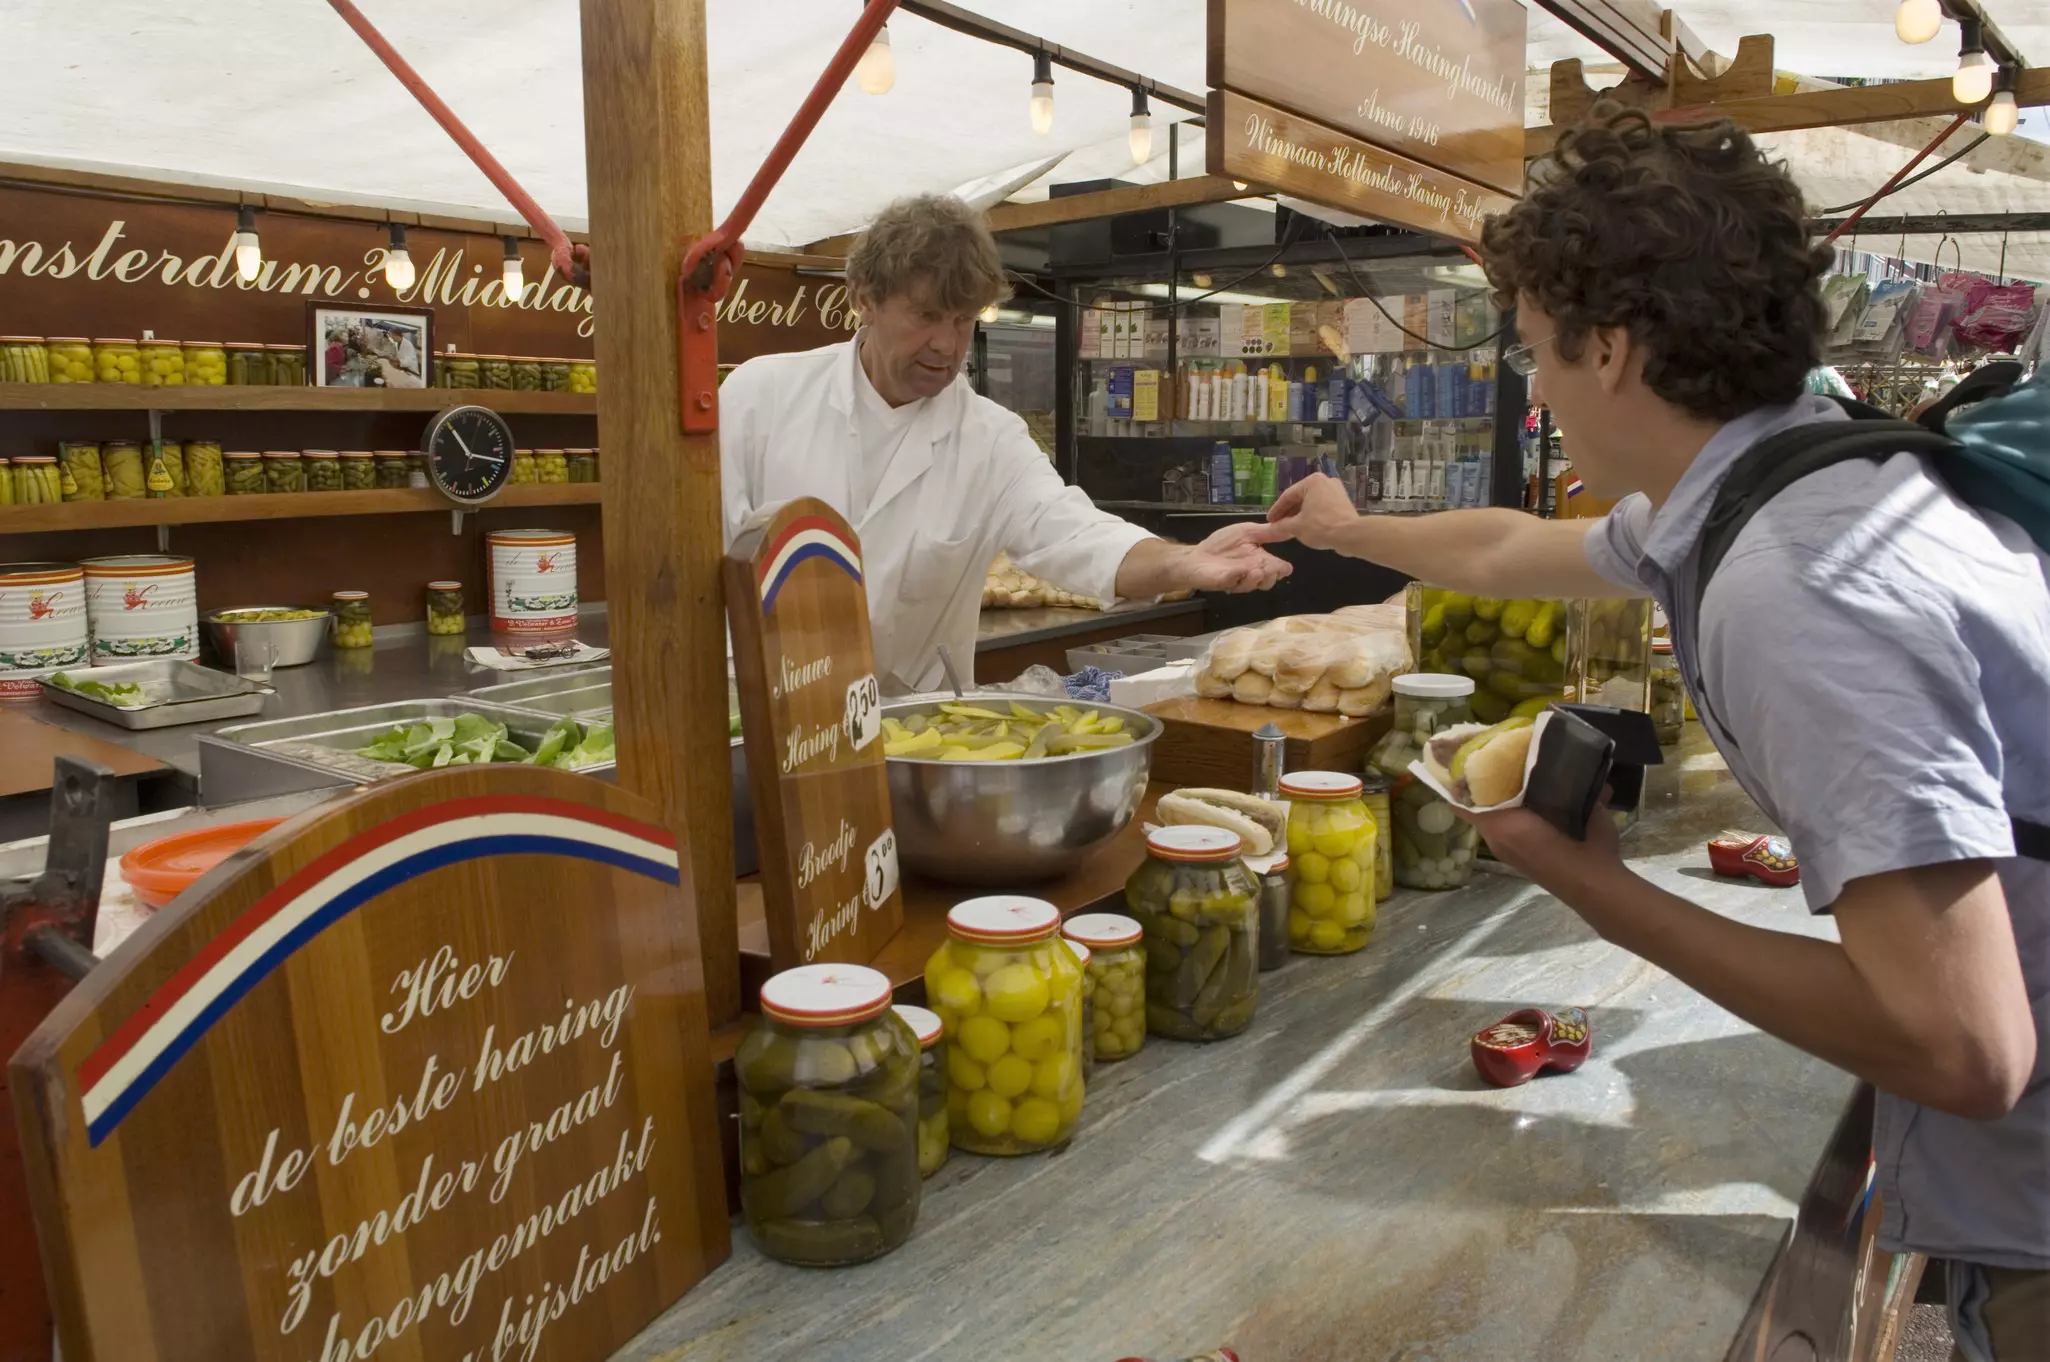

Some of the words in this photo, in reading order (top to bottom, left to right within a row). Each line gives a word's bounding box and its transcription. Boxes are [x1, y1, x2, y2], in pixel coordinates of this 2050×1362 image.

[1393, 20, 1517, 114] Haringhandel
[1357, 87, 1407, 132] Anno
[1245, 113, 1328, 171] Winnaar
[1327, 142, 1404, 194] Hollandse
[1404, 173, 1454, 223] Haring
[773, 654, 833, 699] Nieuwe
[783, 723, 841, 773] Haring
[798, 817, 858, 889] Broodje
[805, 907, 861, 962] Haring
[381, 944, 515, 1034] Hier
[229, 1128, 321, 1218] de
[327, 1053, 468, 1166] beste
[472, 983, 637, 1092] haring
[279, 1151, 489, 1335] zonder
[489, 1049, 626, 1205] graat
